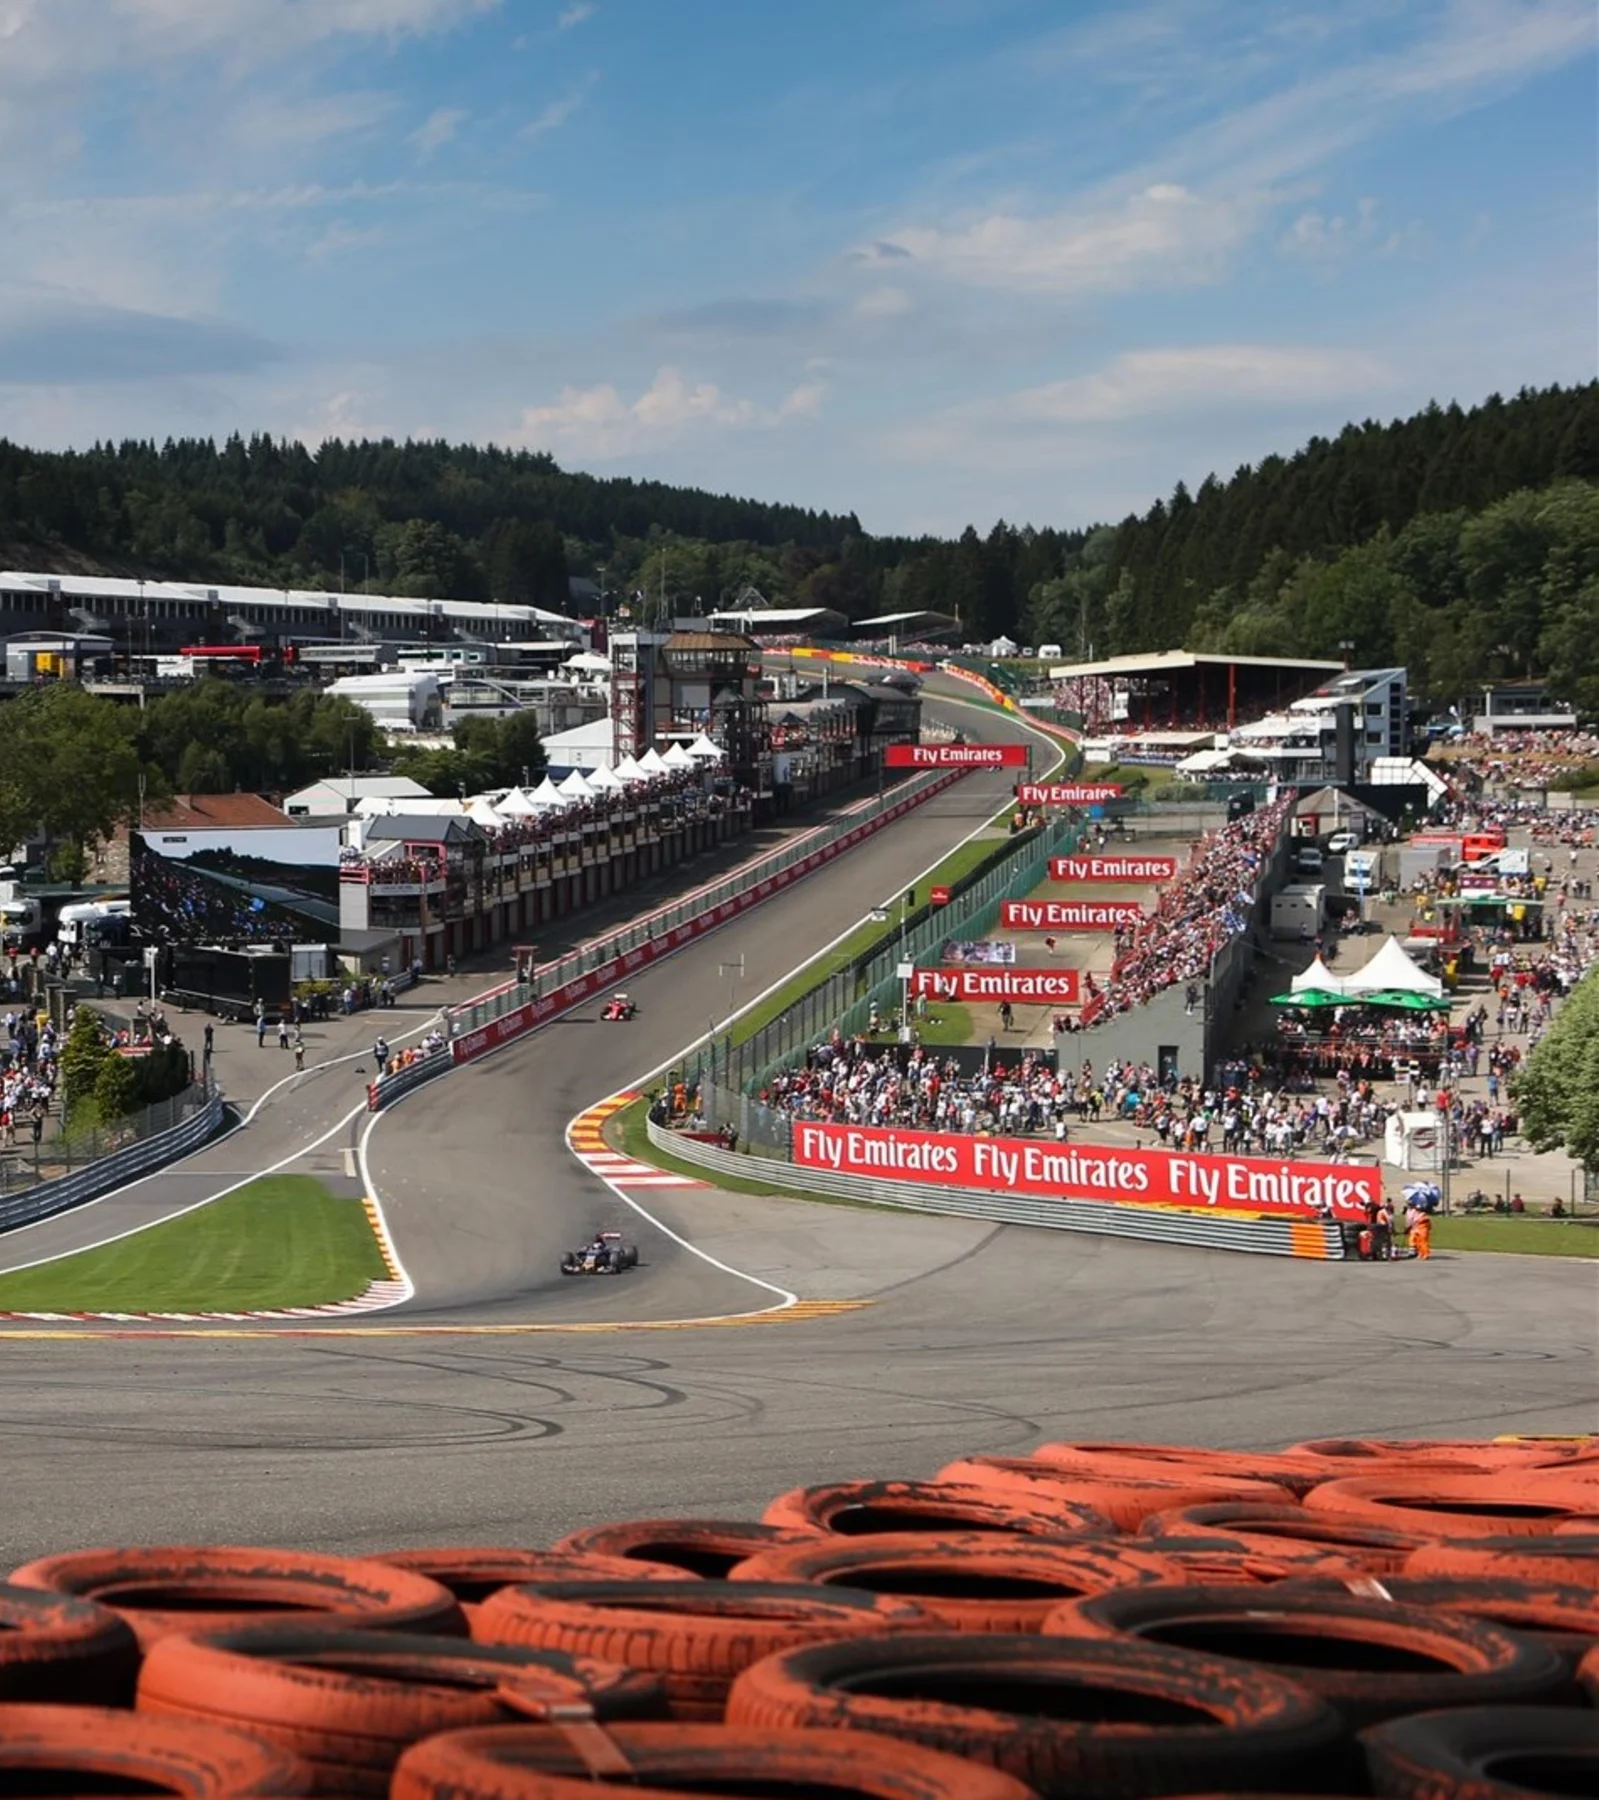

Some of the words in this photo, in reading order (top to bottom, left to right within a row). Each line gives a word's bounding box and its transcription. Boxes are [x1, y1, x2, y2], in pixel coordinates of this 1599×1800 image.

[913, 748, 937, 763] Fly
[940, 747, 1002, 761] Emirates
[1023, 786, 1048, 802] Fly
[1051, 785, 1117, 800] Emirates
[1057, 860, 1087, 879] Fly
[1091, 859, 1170, 876] Emirates
[1008, 904, 1042, 926] Fly
[1047, 904, 1137, 923] Emirates
[918, 972, 958, 996] Fly
[963, 972, 1069, 994] Emirates
[803, 1129, 842, 1168] Fly
[847, 1132, 958, 1173] Emirates
[974, 1143, 1018, 1186] Fly
[1024, 1146, 1148, 1191] Emirates
[1168, 1158, 1220, 1204] Fly
[1227, 1163, 1370, 1210] Emirates
